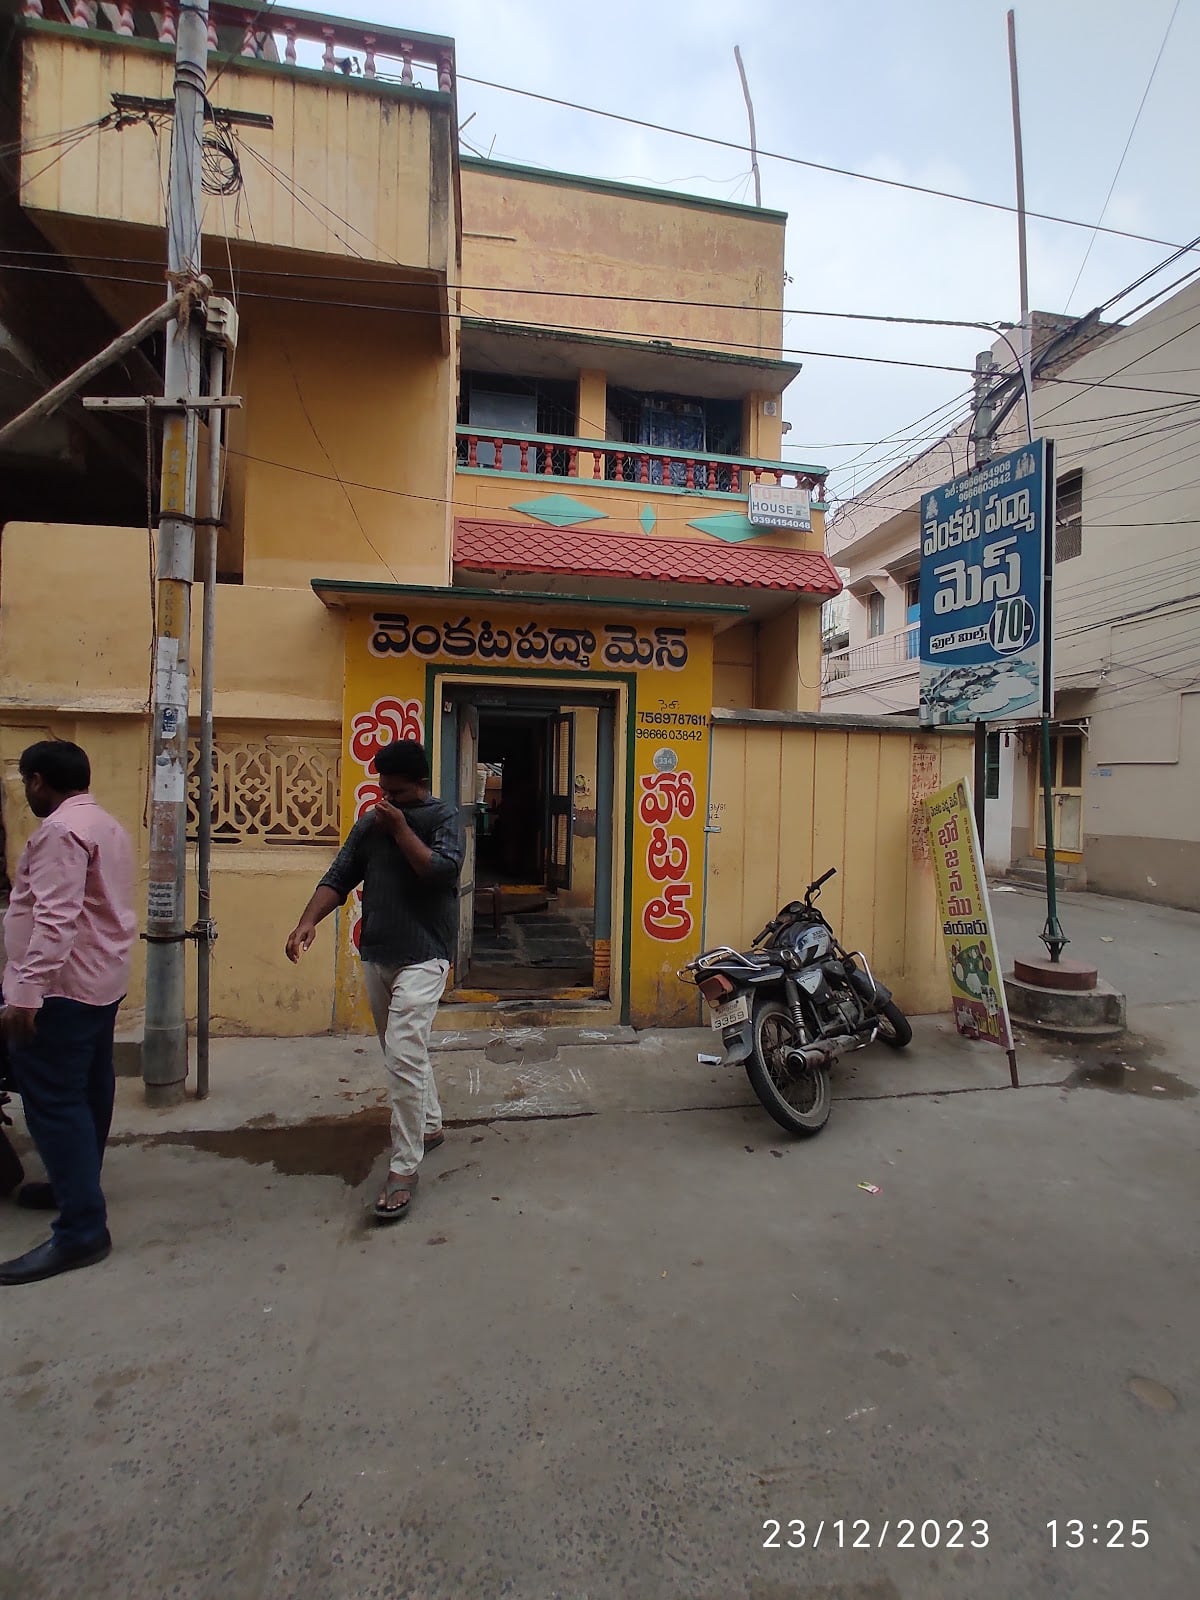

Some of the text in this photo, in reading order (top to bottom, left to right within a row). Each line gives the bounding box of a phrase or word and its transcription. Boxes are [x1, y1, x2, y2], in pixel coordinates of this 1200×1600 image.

[958, 472, 1011, 503] 9666603842
[752, 501, 794, 515] HOUSE
[752, 516, 811, 529] 9394154048
[923, 505, 981, 557] వెంకట
[933, 536, 1021, 617] మెస్
[603, 624, 689, 670] మెస్
[635, 728, 702, 741] 9666603842
[943, 919, 988, 935] తయారు
